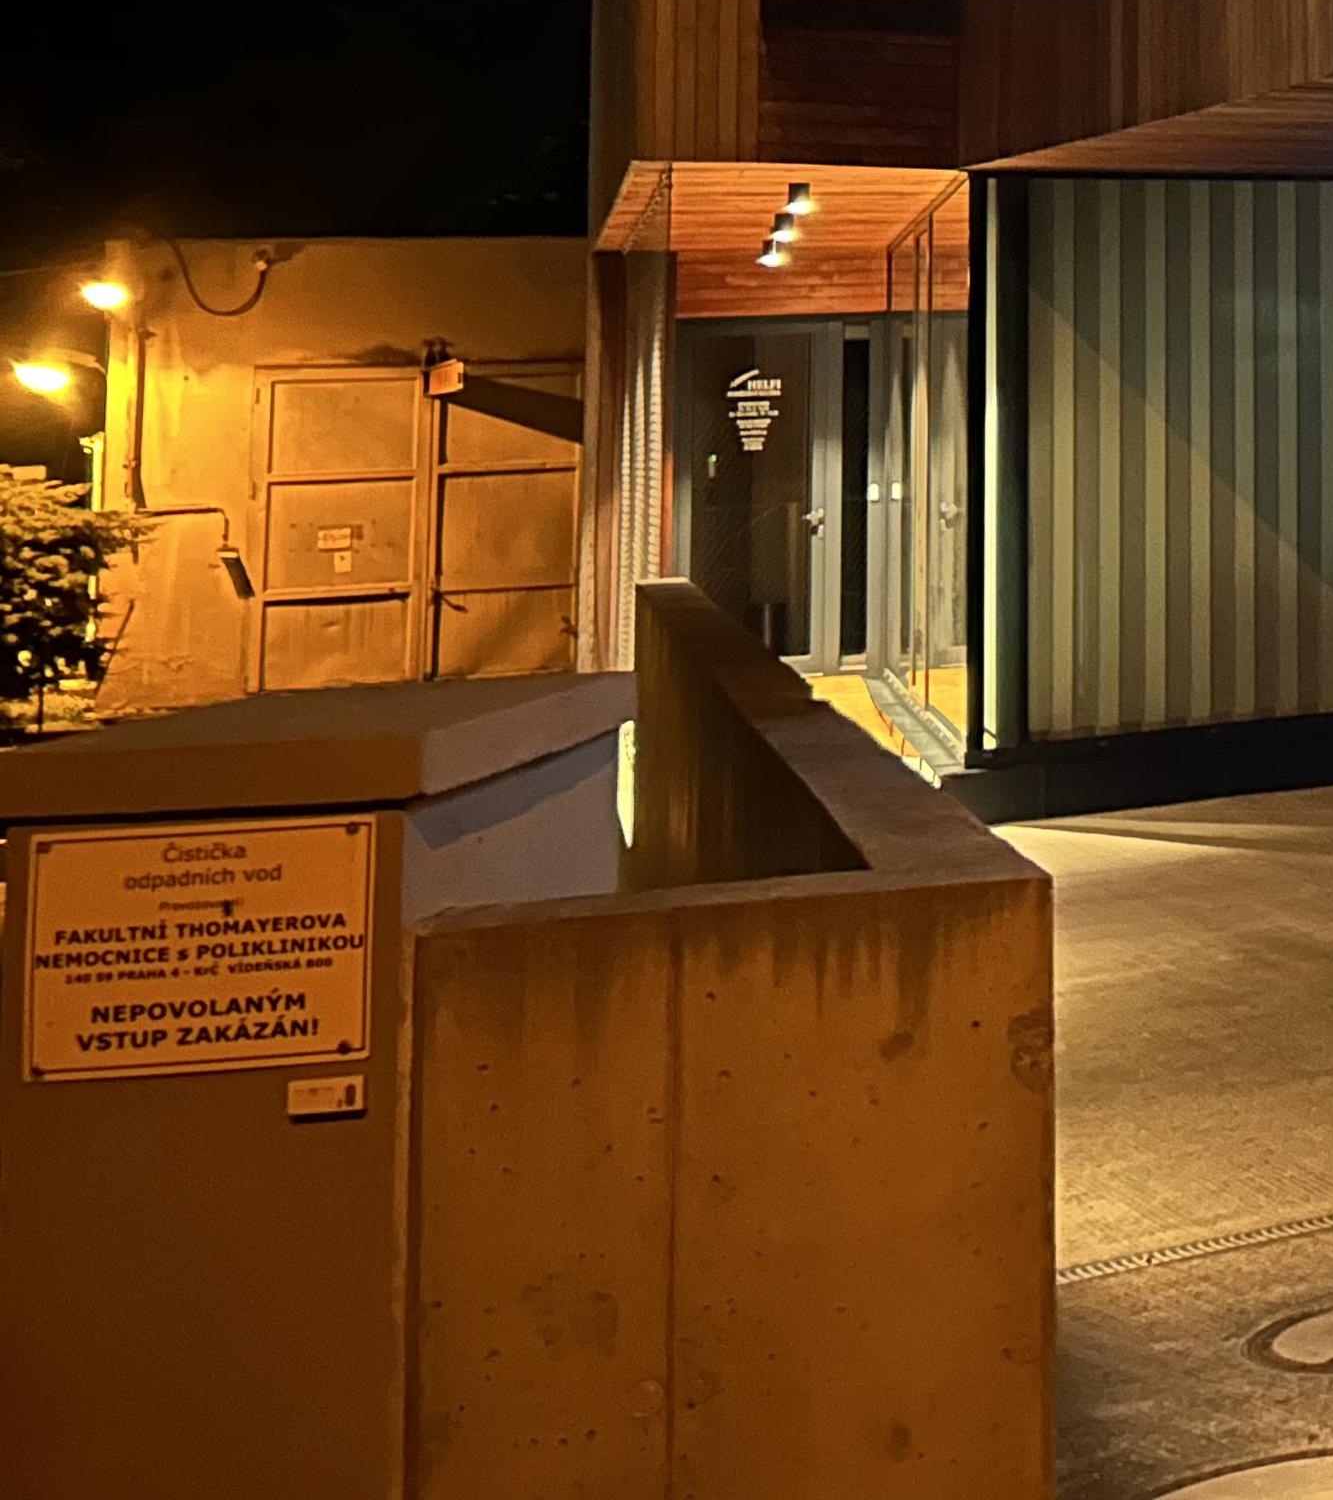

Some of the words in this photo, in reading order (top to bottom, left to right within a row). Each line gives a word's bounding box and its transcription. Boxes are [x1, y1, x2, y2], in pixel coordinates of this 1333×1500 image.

[163, 842, 247, 863] Čistička
[123, 867, 235, 893] odpadních
[243, 864, 283, 882] vod
[54, 918, 168, 946] FAKULTNÍ
[175, 912, 347, 939] THOMAYEROVA
[35, 946, 171, 970] NEMOCNICE
[196, 934, 365, 960] POLIKLINIKOU
[117, 968, 167, 981] PRAHA
[228, 957, 302, 975] VÍDEŇSKÁ
[90, 987, 307, 1024] NEPOVOLANÝM
[76, 1029, 168, 1052] VSTUP
[177, 1014, 319, 1047] ZAKÁZÁN!
